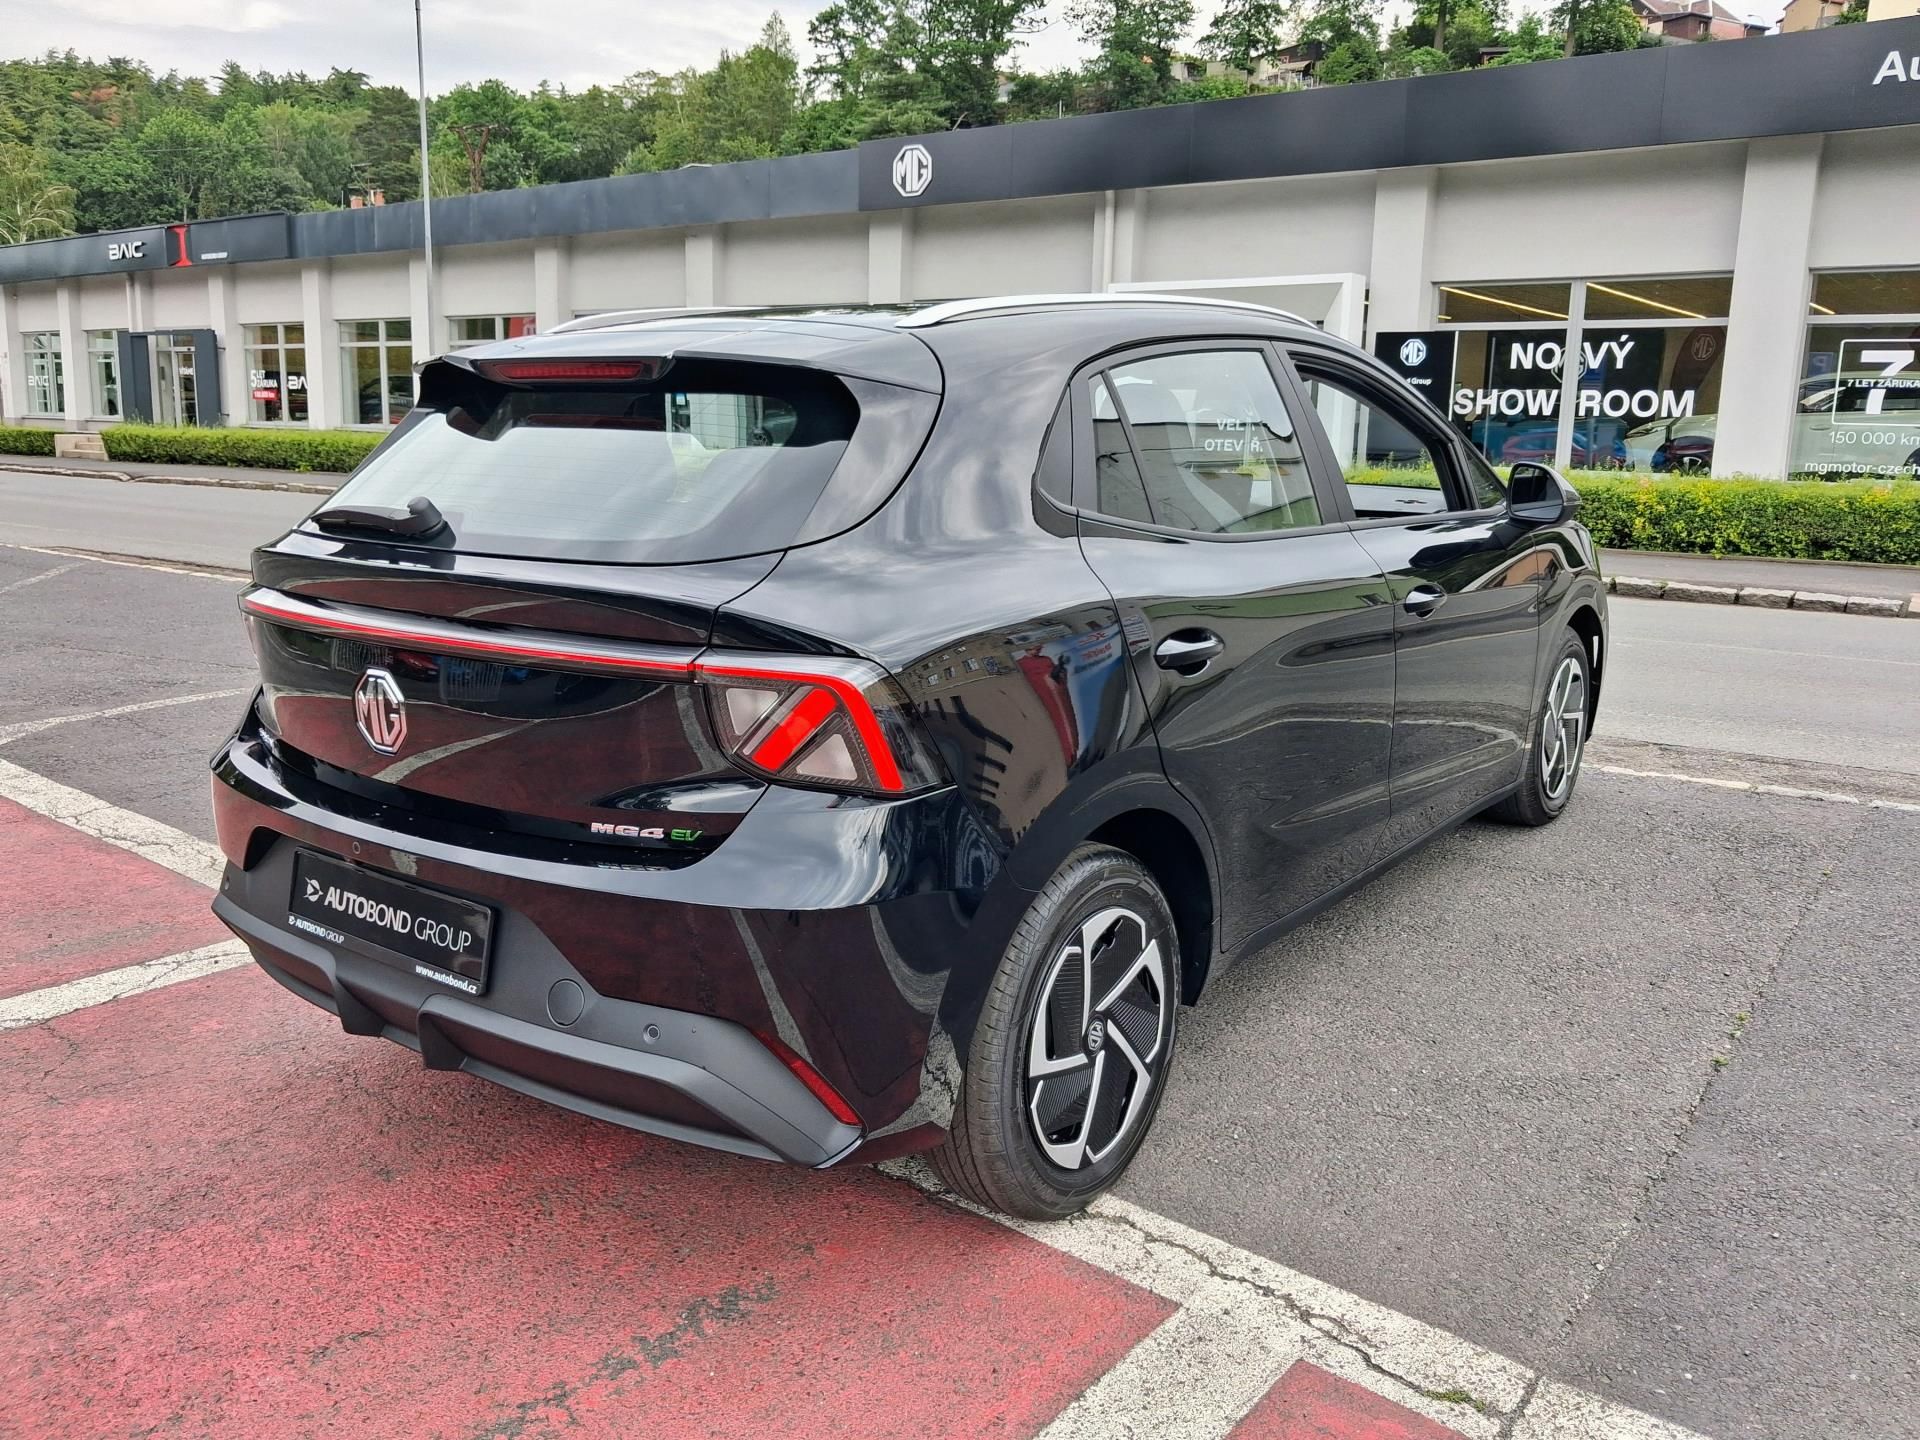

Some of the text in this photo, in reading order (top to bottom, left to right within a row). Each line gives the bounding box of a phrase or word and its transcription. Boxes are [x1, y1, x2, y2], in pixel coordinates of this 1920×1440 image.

[894, 146, 931, 195] MG
[108, 241, 144, 260] BAIC
[1401, 340, 1426, 366] MG
[1509, 334, 1636, 370] NOVÝ
[1692, 334, 1716, 360] MG
[1411, 377, 1432, 387] Group
[1847, 377, 1920, 388] 7 LET ZÁRUKA
[1216, 418, 1255, 432] VEL
[1204, 436, 1263, 453] OTEVŘ
[1829, 431, 1857, 444] 150
[1861, 431, 1896, 445] 000
[357, 673, 403, 749] MG
[590, 822, 703, 841] MG4 EV
[295, 919, 345, 944] AUTOBOND GROUP
[324, 886, 472, 953] AUTOBOND GROUP
[415, 964, 477, 994] www.autobond.cz
[1088, 1021, 1104, 1051] MG
